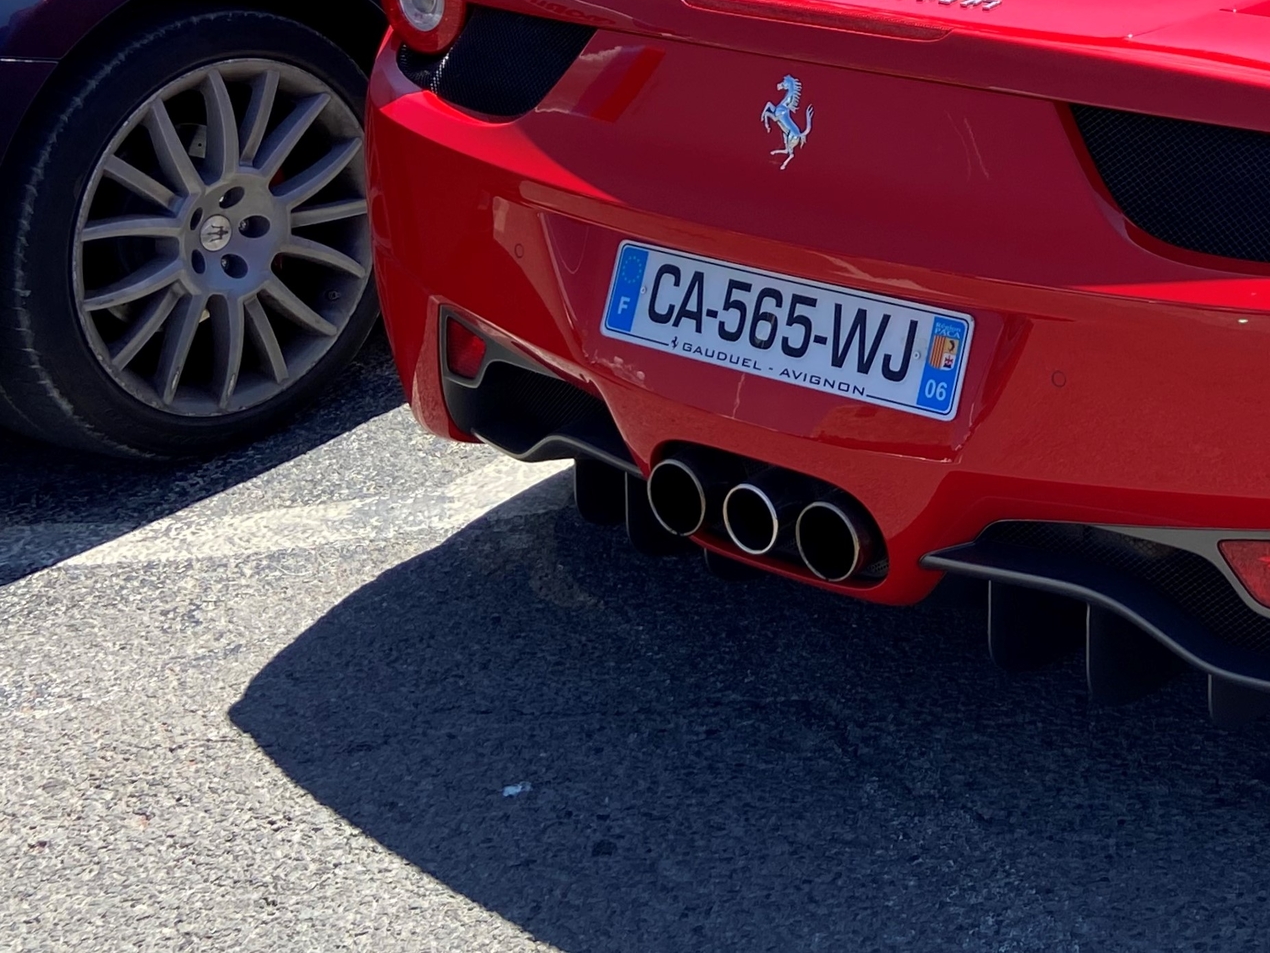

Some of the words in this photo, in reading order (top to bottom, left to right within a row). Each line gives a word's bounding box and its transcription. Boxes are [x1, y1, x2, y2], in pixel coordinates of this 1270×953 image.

[617, 296, 630, 314] F
[648, 264, 918, 382] CA-565-WJ
[934, 328, 960, 339] PACA
[682, 342, 762, 371] GAUDUEL
[779, 367, 865, 397] AVIGNON
[925, 379, 948, 401] 06
